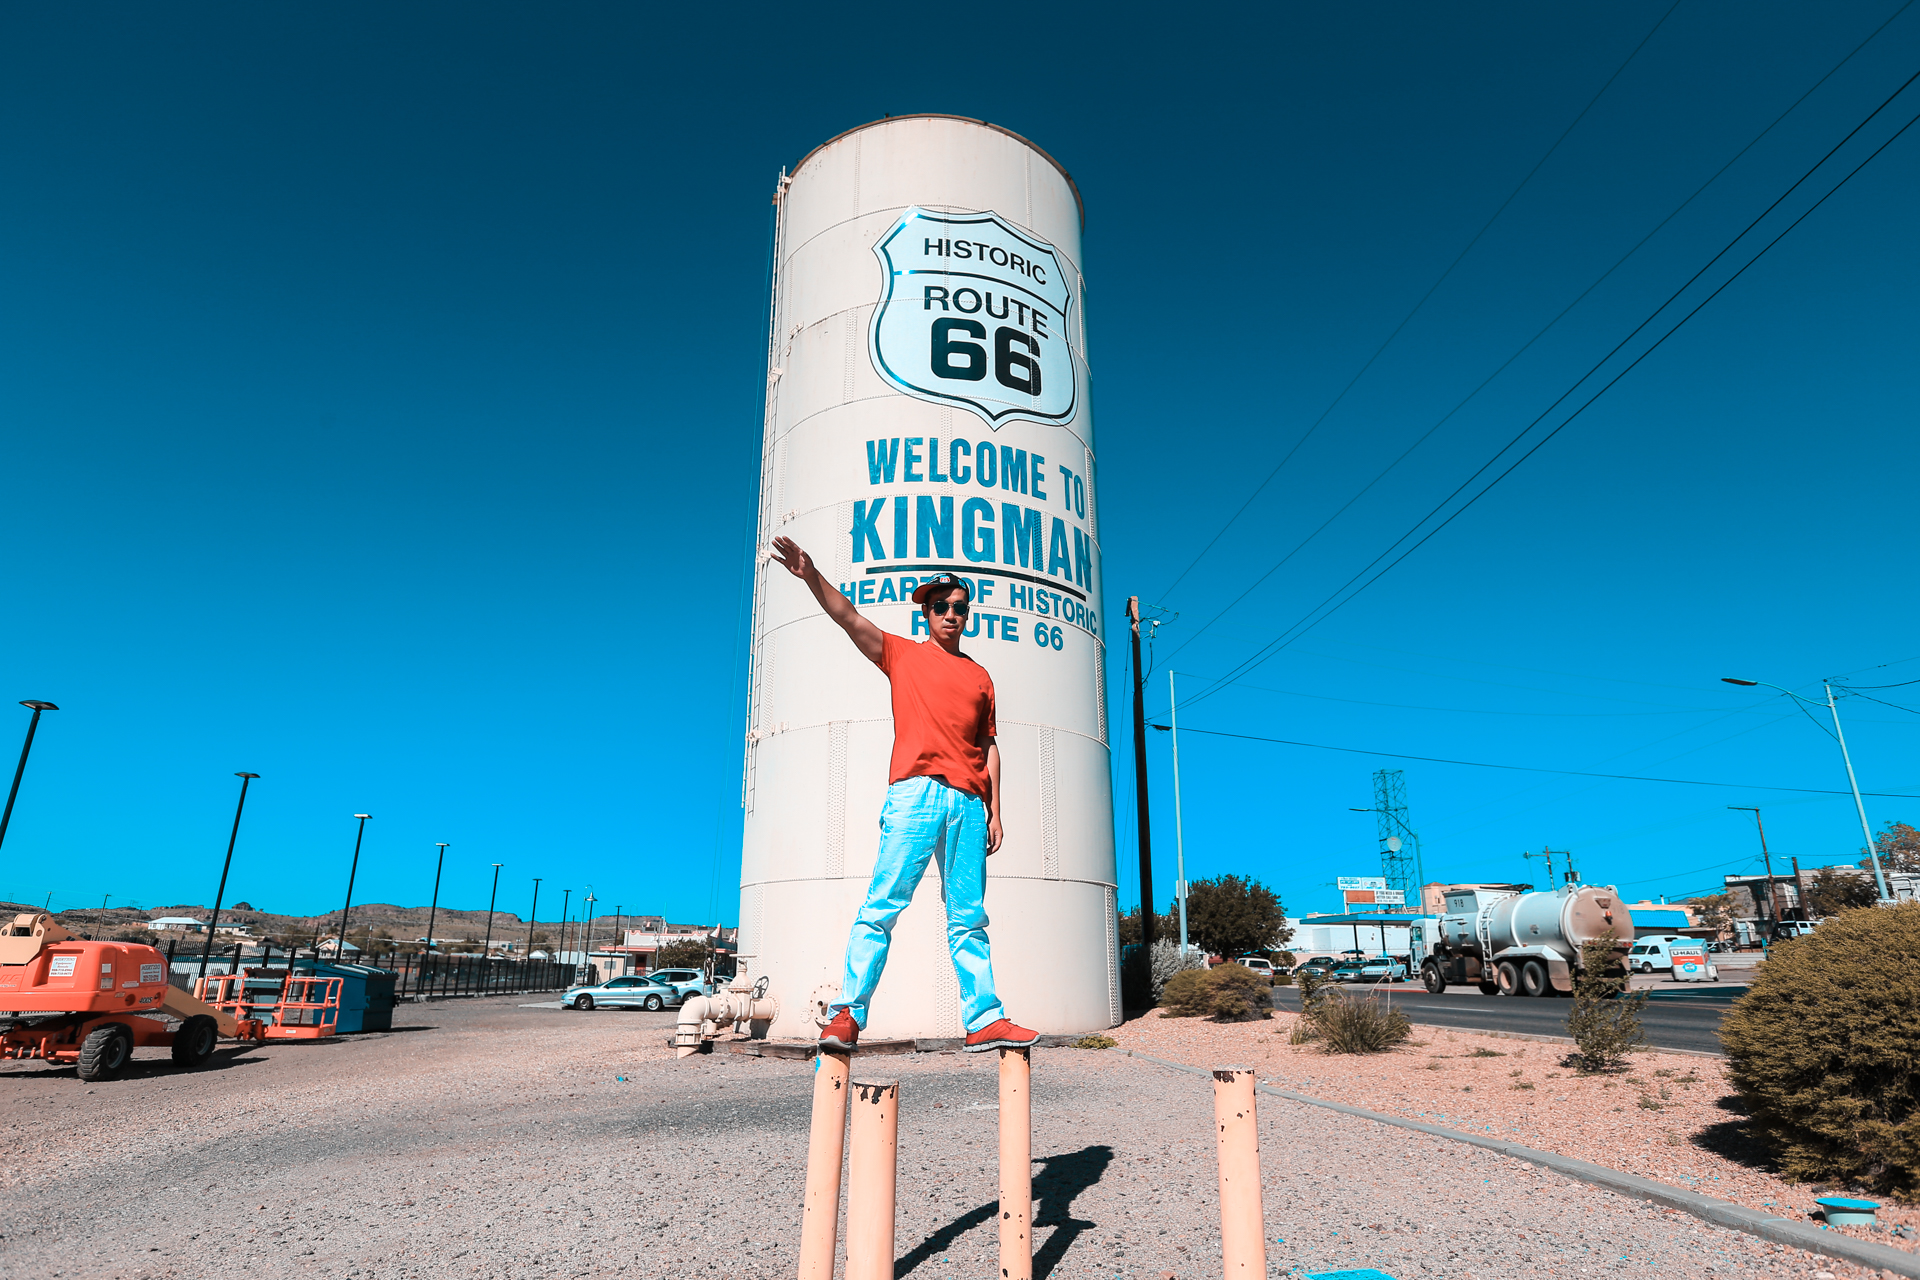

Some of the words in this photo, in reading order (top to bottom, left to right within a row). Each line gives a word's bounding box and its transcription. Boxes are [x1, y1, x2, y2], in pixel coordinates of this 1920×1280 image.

[924, 237, 1047, 285] HISTORIC
[923, 285, 1049, 340] ROUTE
[930, 316, 1042, 397] 66
[866, 437, 1048, 501] WELCOME
[1059, 464, 1085, 520] TO
[850, 495, 1093, 594] KINGMAN
[911, 610, 1020, 643] RUTE
[1033, 621, 1064, 651] 66
[1009, 583, 1098, 635] HISTORIC
[1453, 898, 1464, 908] 918
